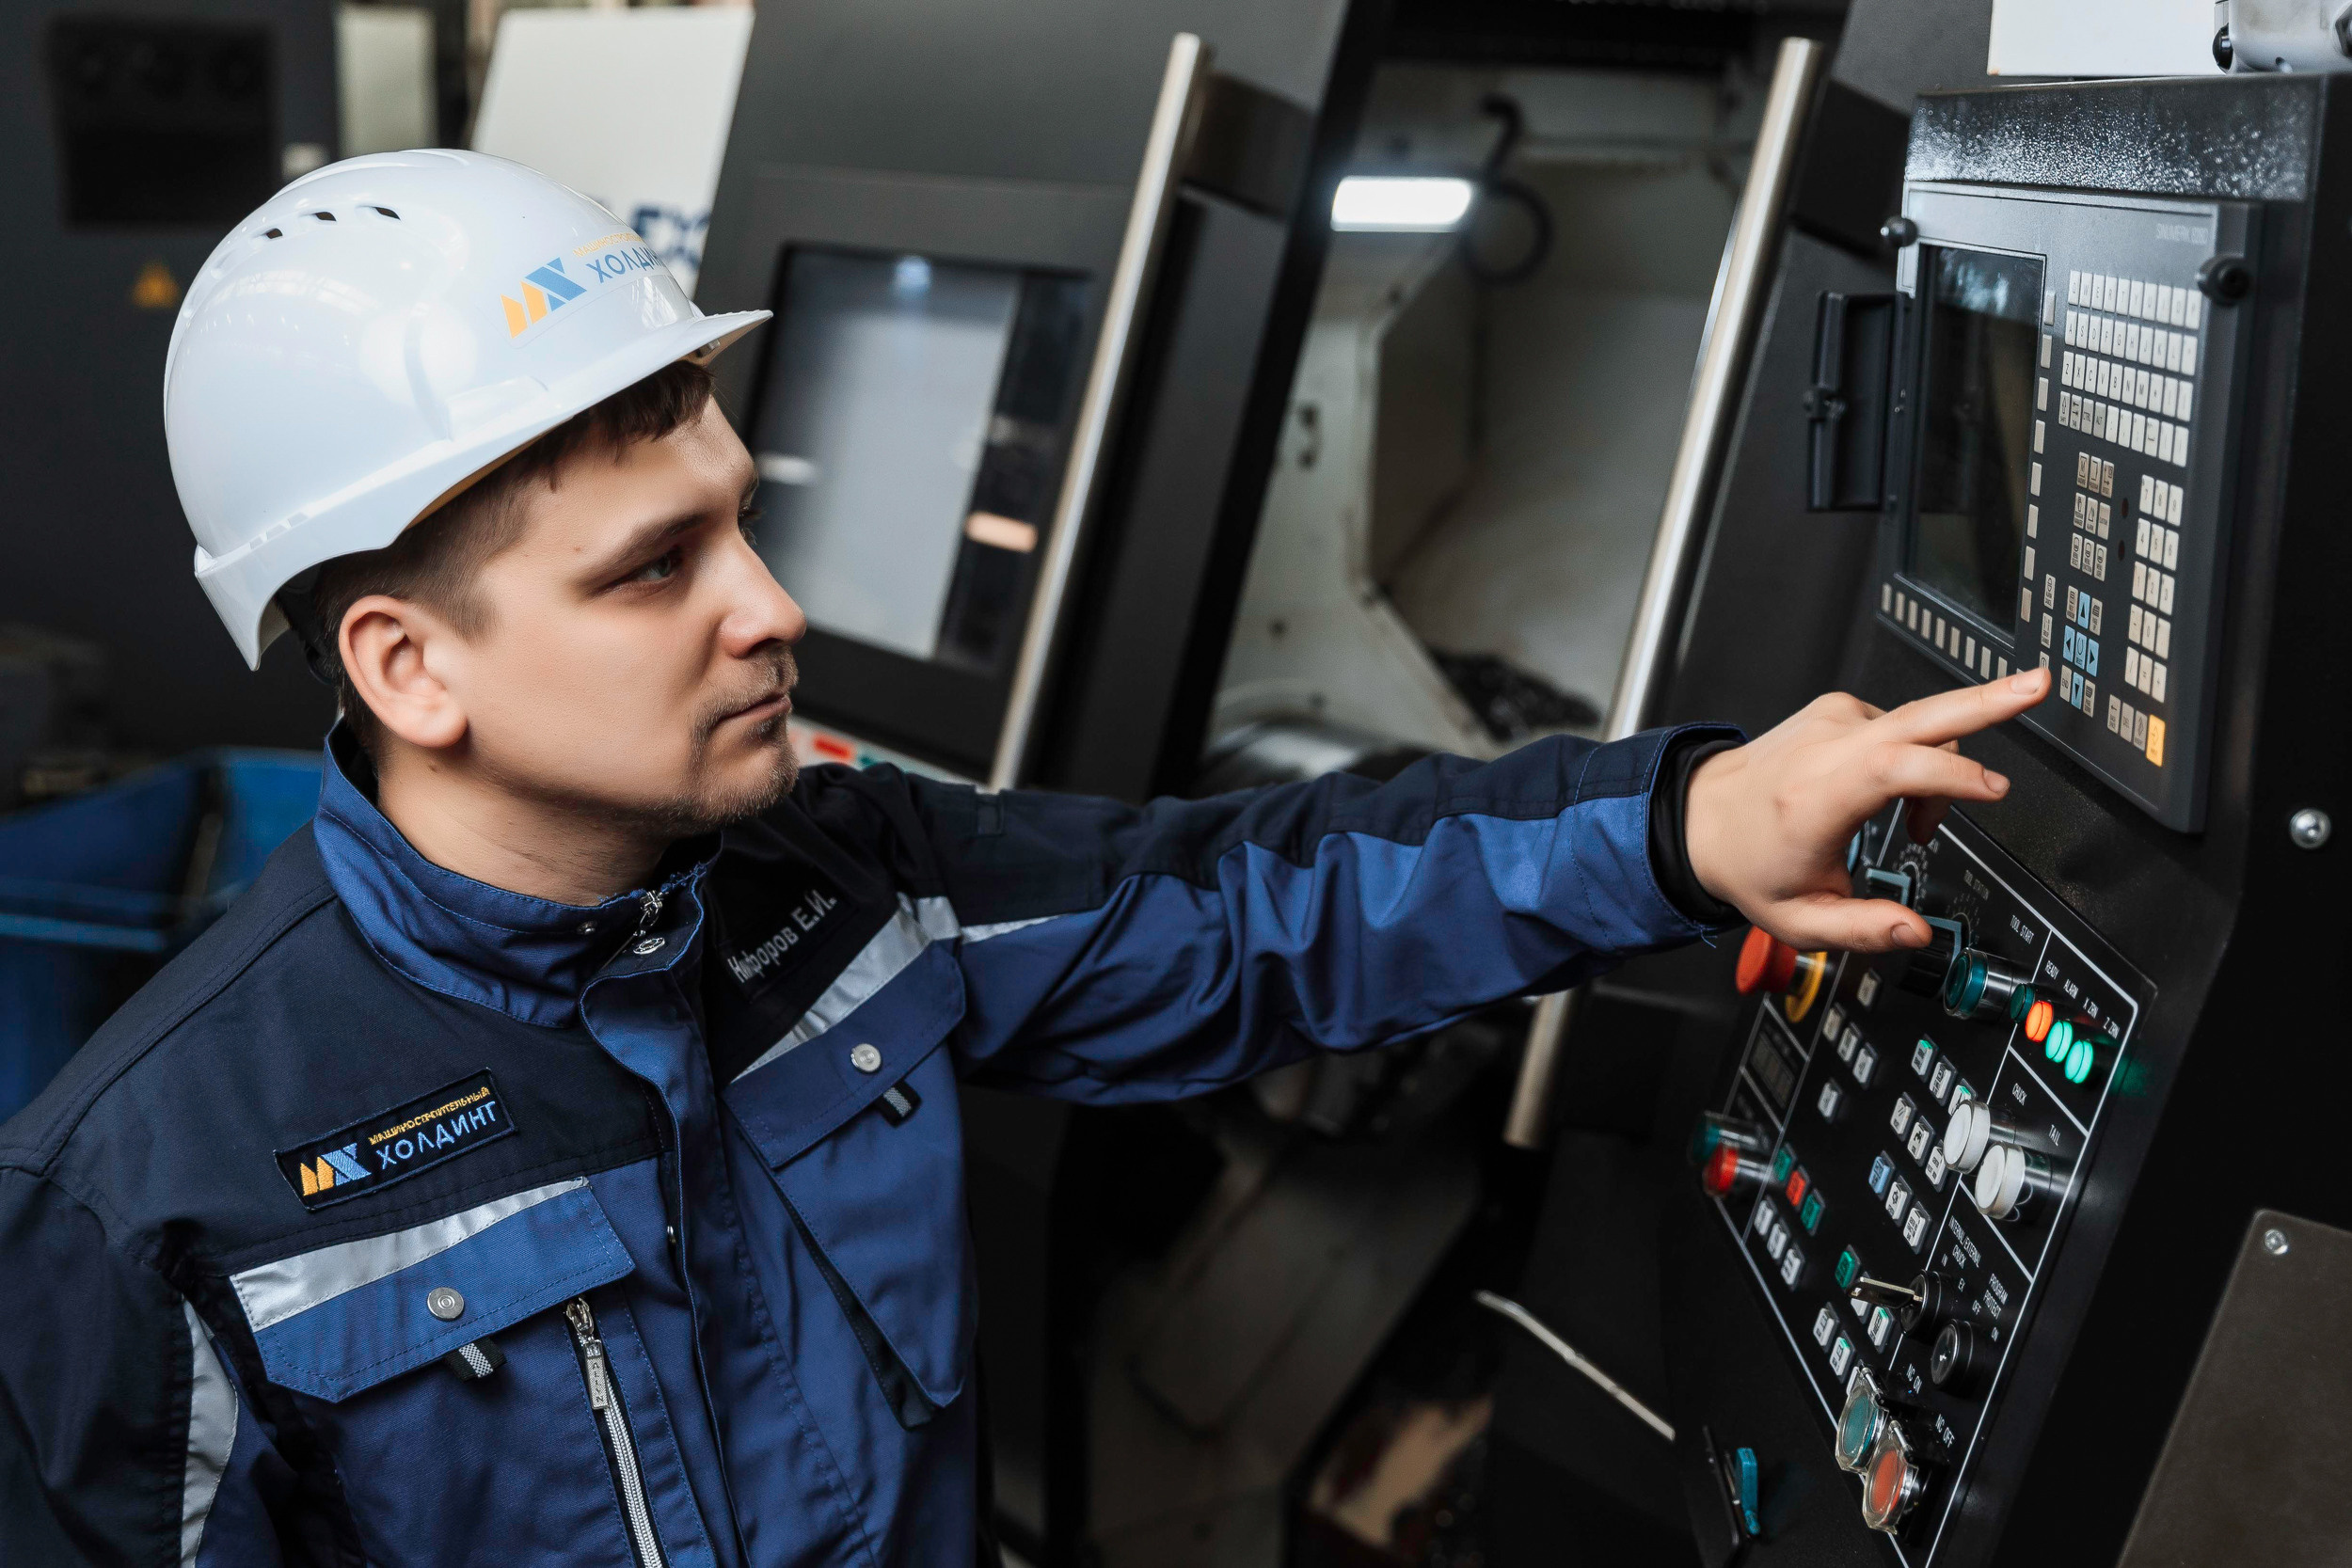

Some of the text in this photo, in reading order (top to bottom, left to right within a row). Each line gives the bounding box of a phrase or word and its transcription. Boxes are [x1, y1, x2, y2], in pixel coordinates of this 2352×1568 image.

[585, 247, 667, 284] ХОЛДИН
[2010, 914, 2034, 944] TOOL START
[2045, 960, 2059, 979] READY
[2063, 979, 2079, 999] ALARM
[2012, 1083, 2027, 1106] CHUCK
[2049, 1124, 2060, 1147] TAIL
[1952, 1244, 1966, 1269] CHUCK
[1989, 1273, 2009, 1306] PROGRAM
[1972, 1300, 1981, 1315] OFF
[1983, 1290, 2001, 1320] PROTECT
[1906, 1363, 1923, 1394] NC ON
[1935, 1414, 1955, 1449] NC OFF
